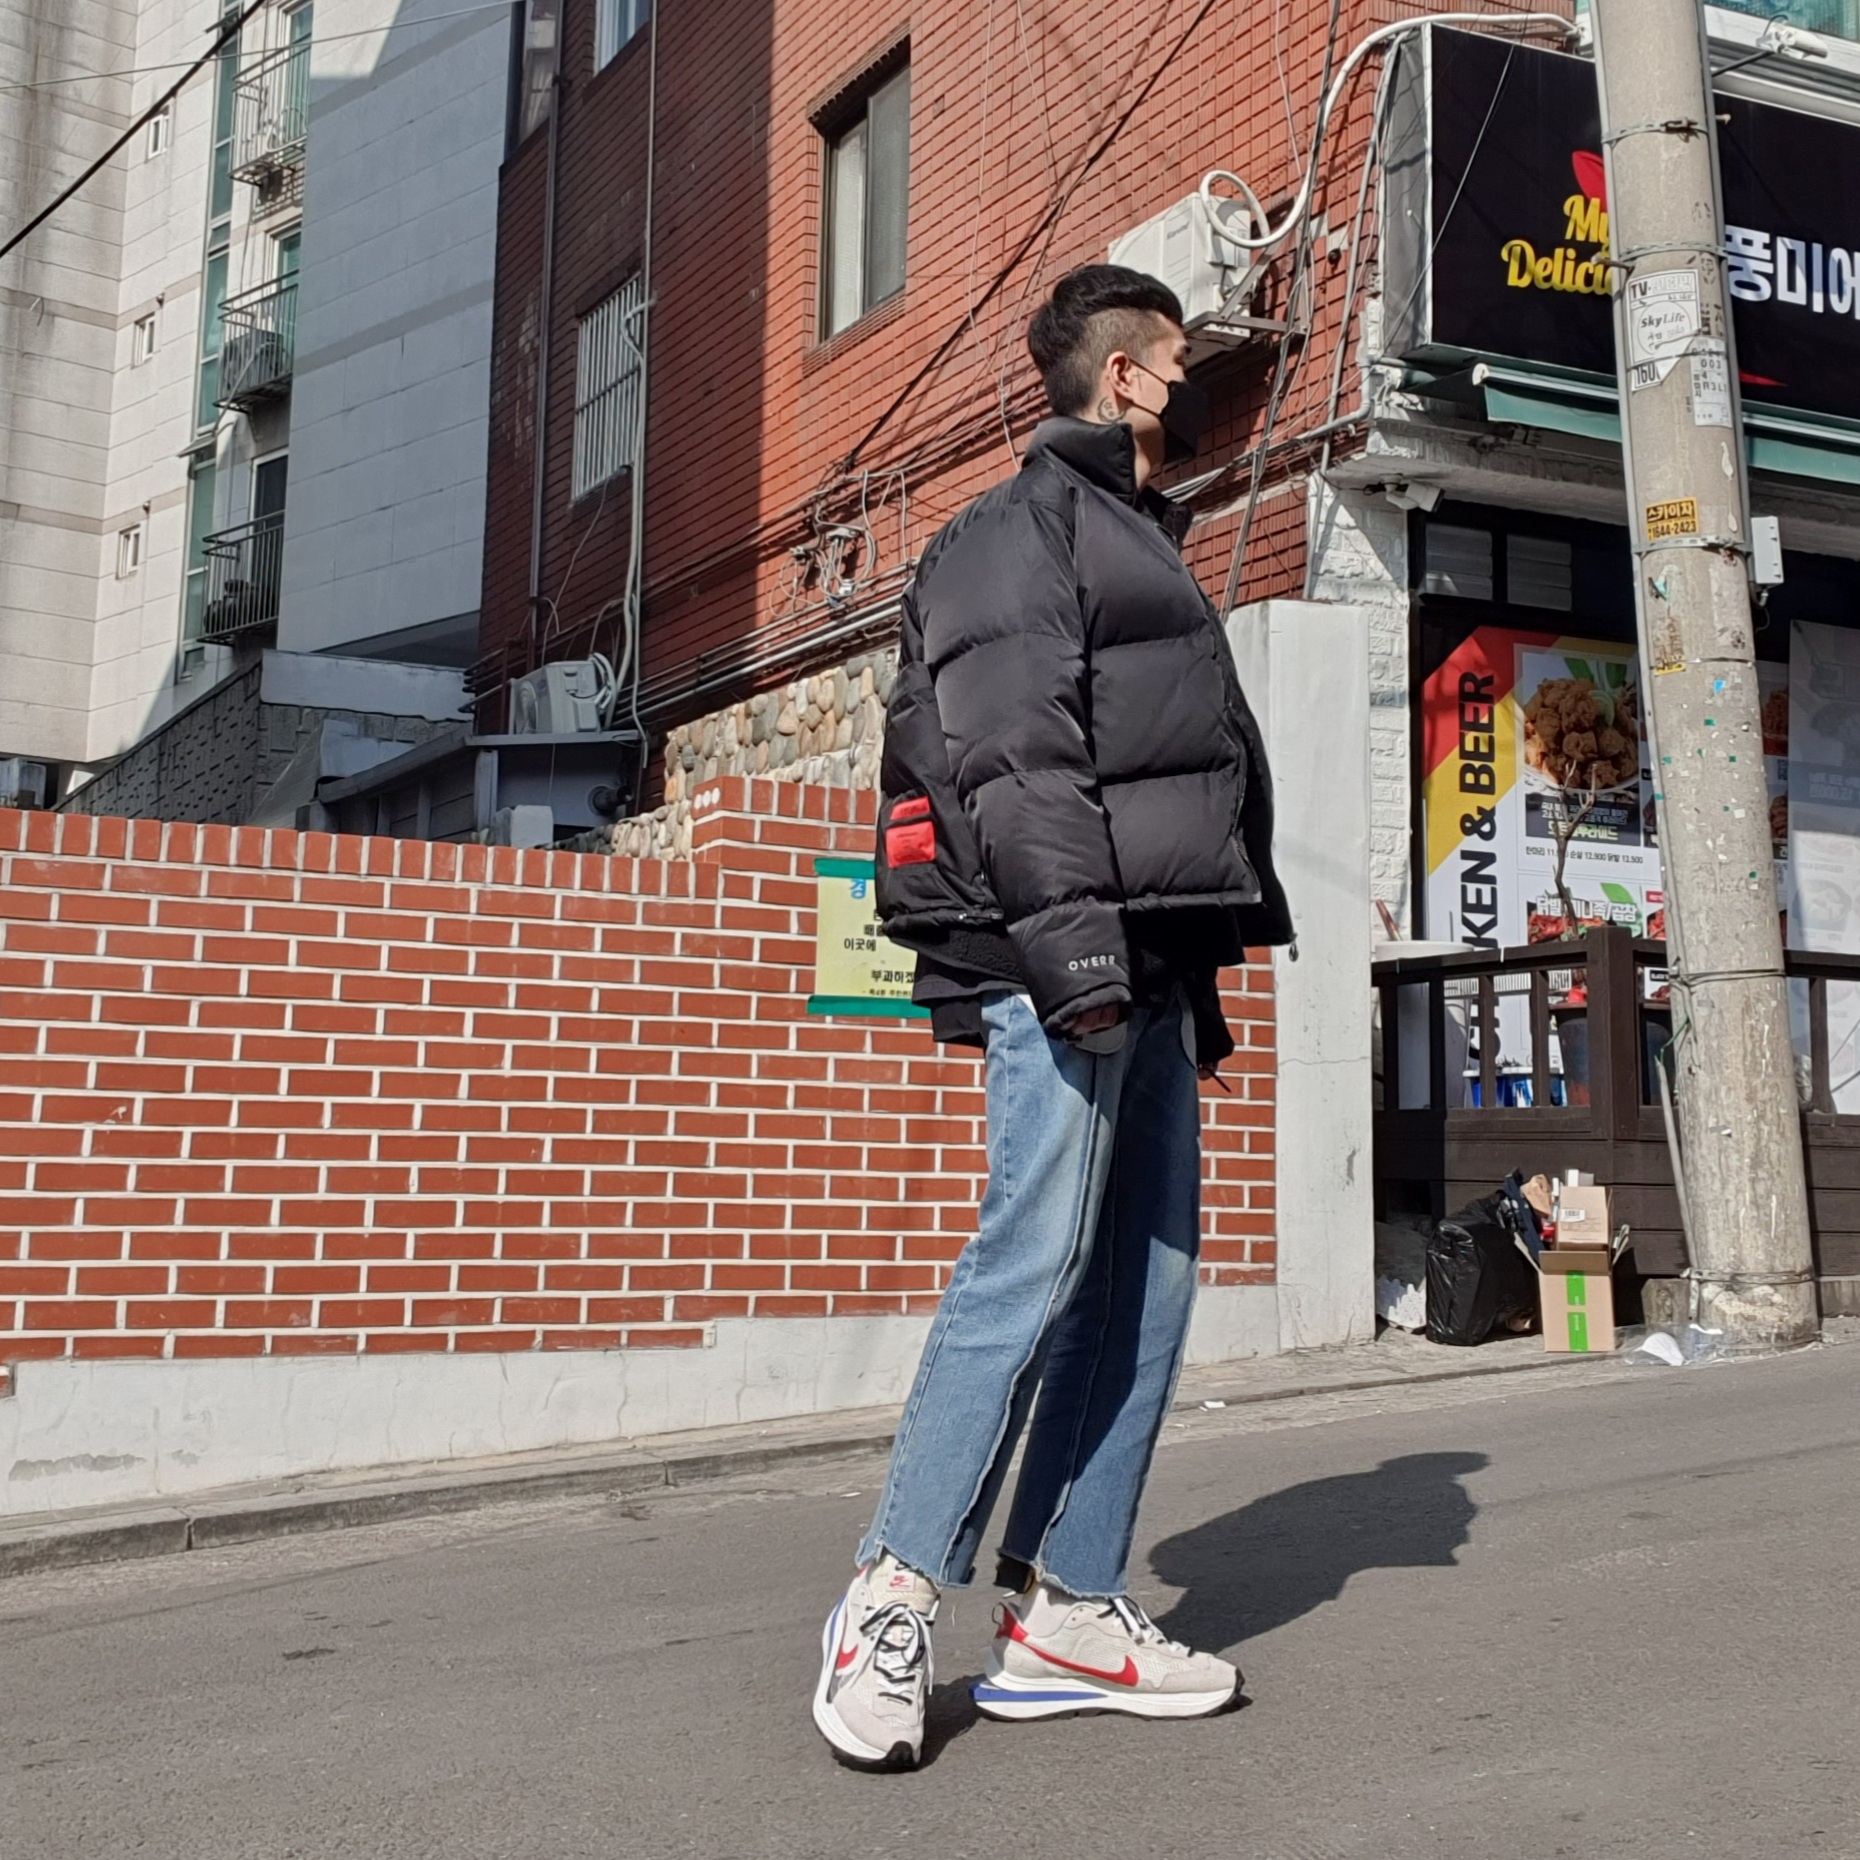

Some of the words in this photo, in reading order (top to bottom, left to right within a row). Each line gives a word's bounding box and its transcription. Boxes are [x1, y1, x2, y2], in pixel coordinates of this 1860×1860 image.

[1458, 671, 1496, 795] BEER
[1459, 805, 1497, 842] &
[843, 938, 877, 952] 이곳에
[1068, 954, 1116, 971] OVERR
